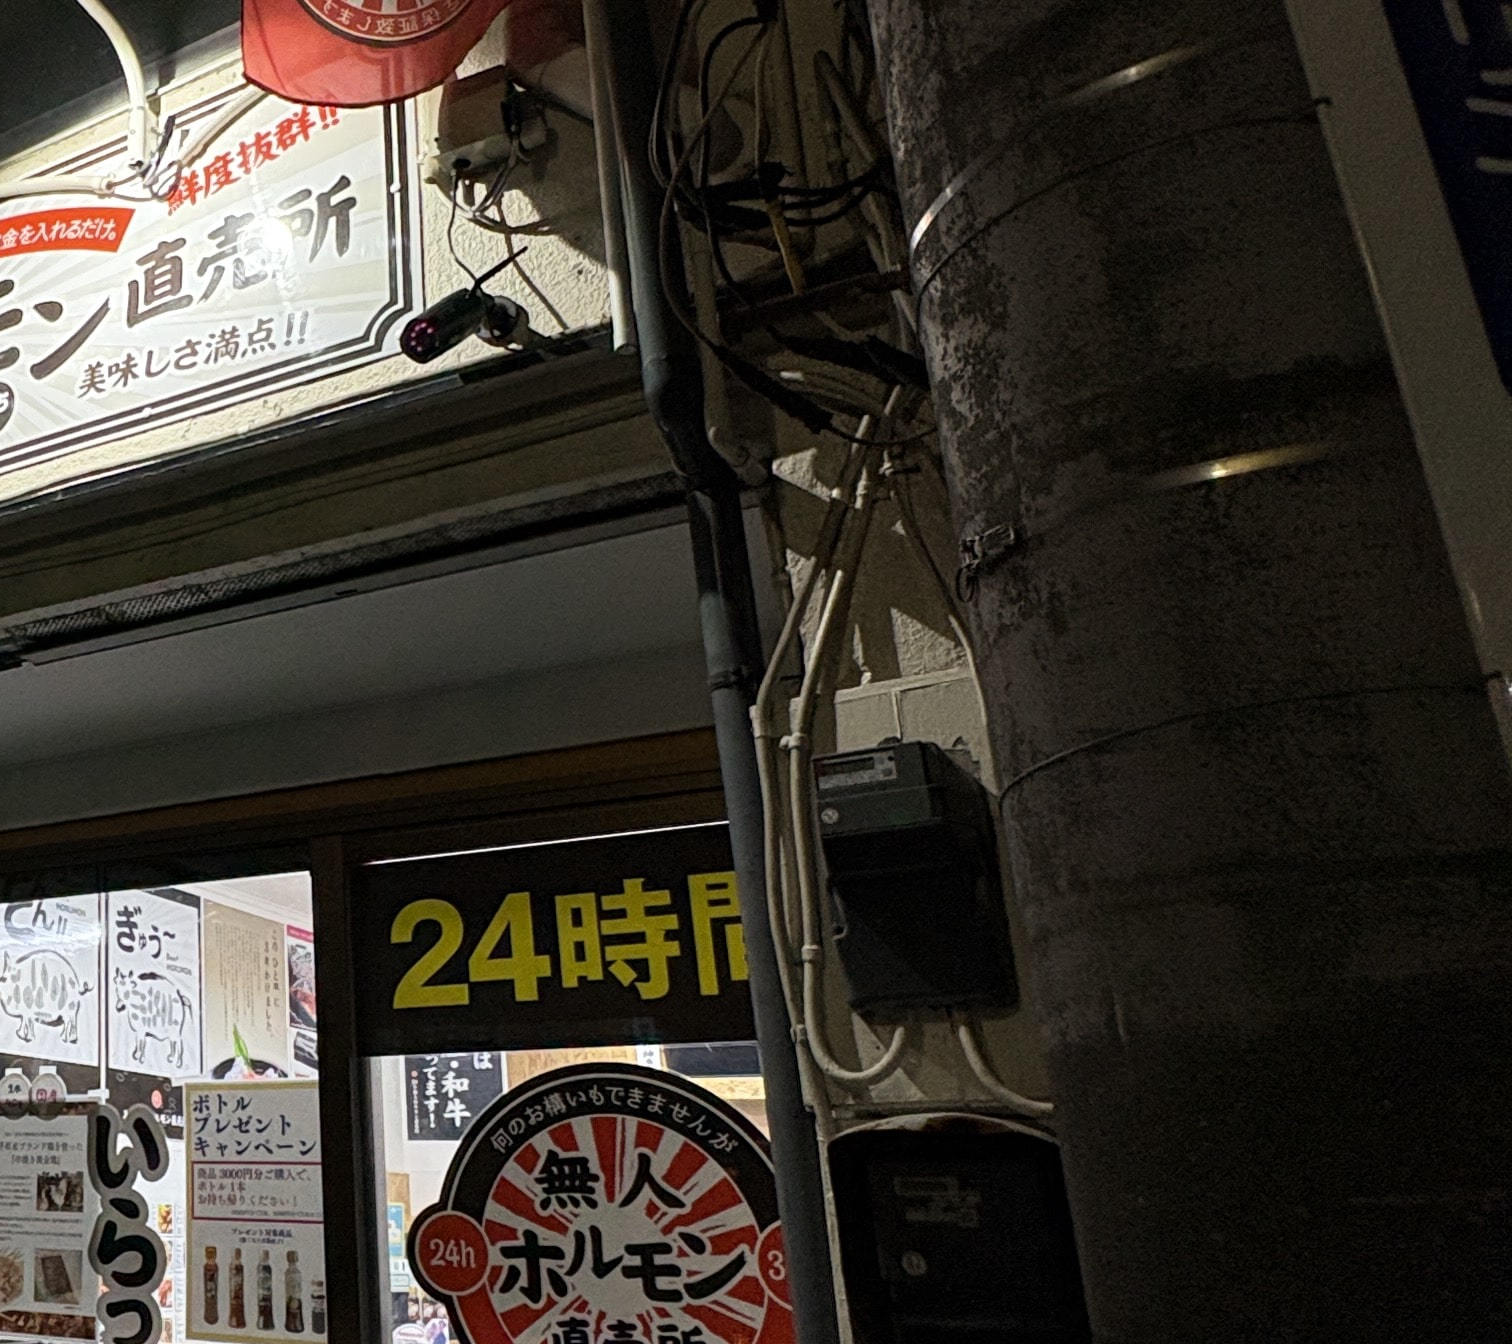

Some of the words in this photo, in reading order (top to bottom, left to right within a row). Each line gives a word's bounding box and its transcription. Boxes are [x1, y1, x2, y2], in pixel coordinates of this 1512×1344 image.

[78, 311, 309, 398] 美味しさ満点!!
[192, 1093, 253, 1114] ボトル
[193, 1114, 292, 1136] プレゼント
[490, 1082, 739, 1154] 何のお構いもできませんが
[193, 1137, 318, 1158] キャンペーン
[537, 1150, 682, 1209] 無人
[429, 1238, 477, 1271] 24h
[498, 1224, 749, 1304] ホルモン
